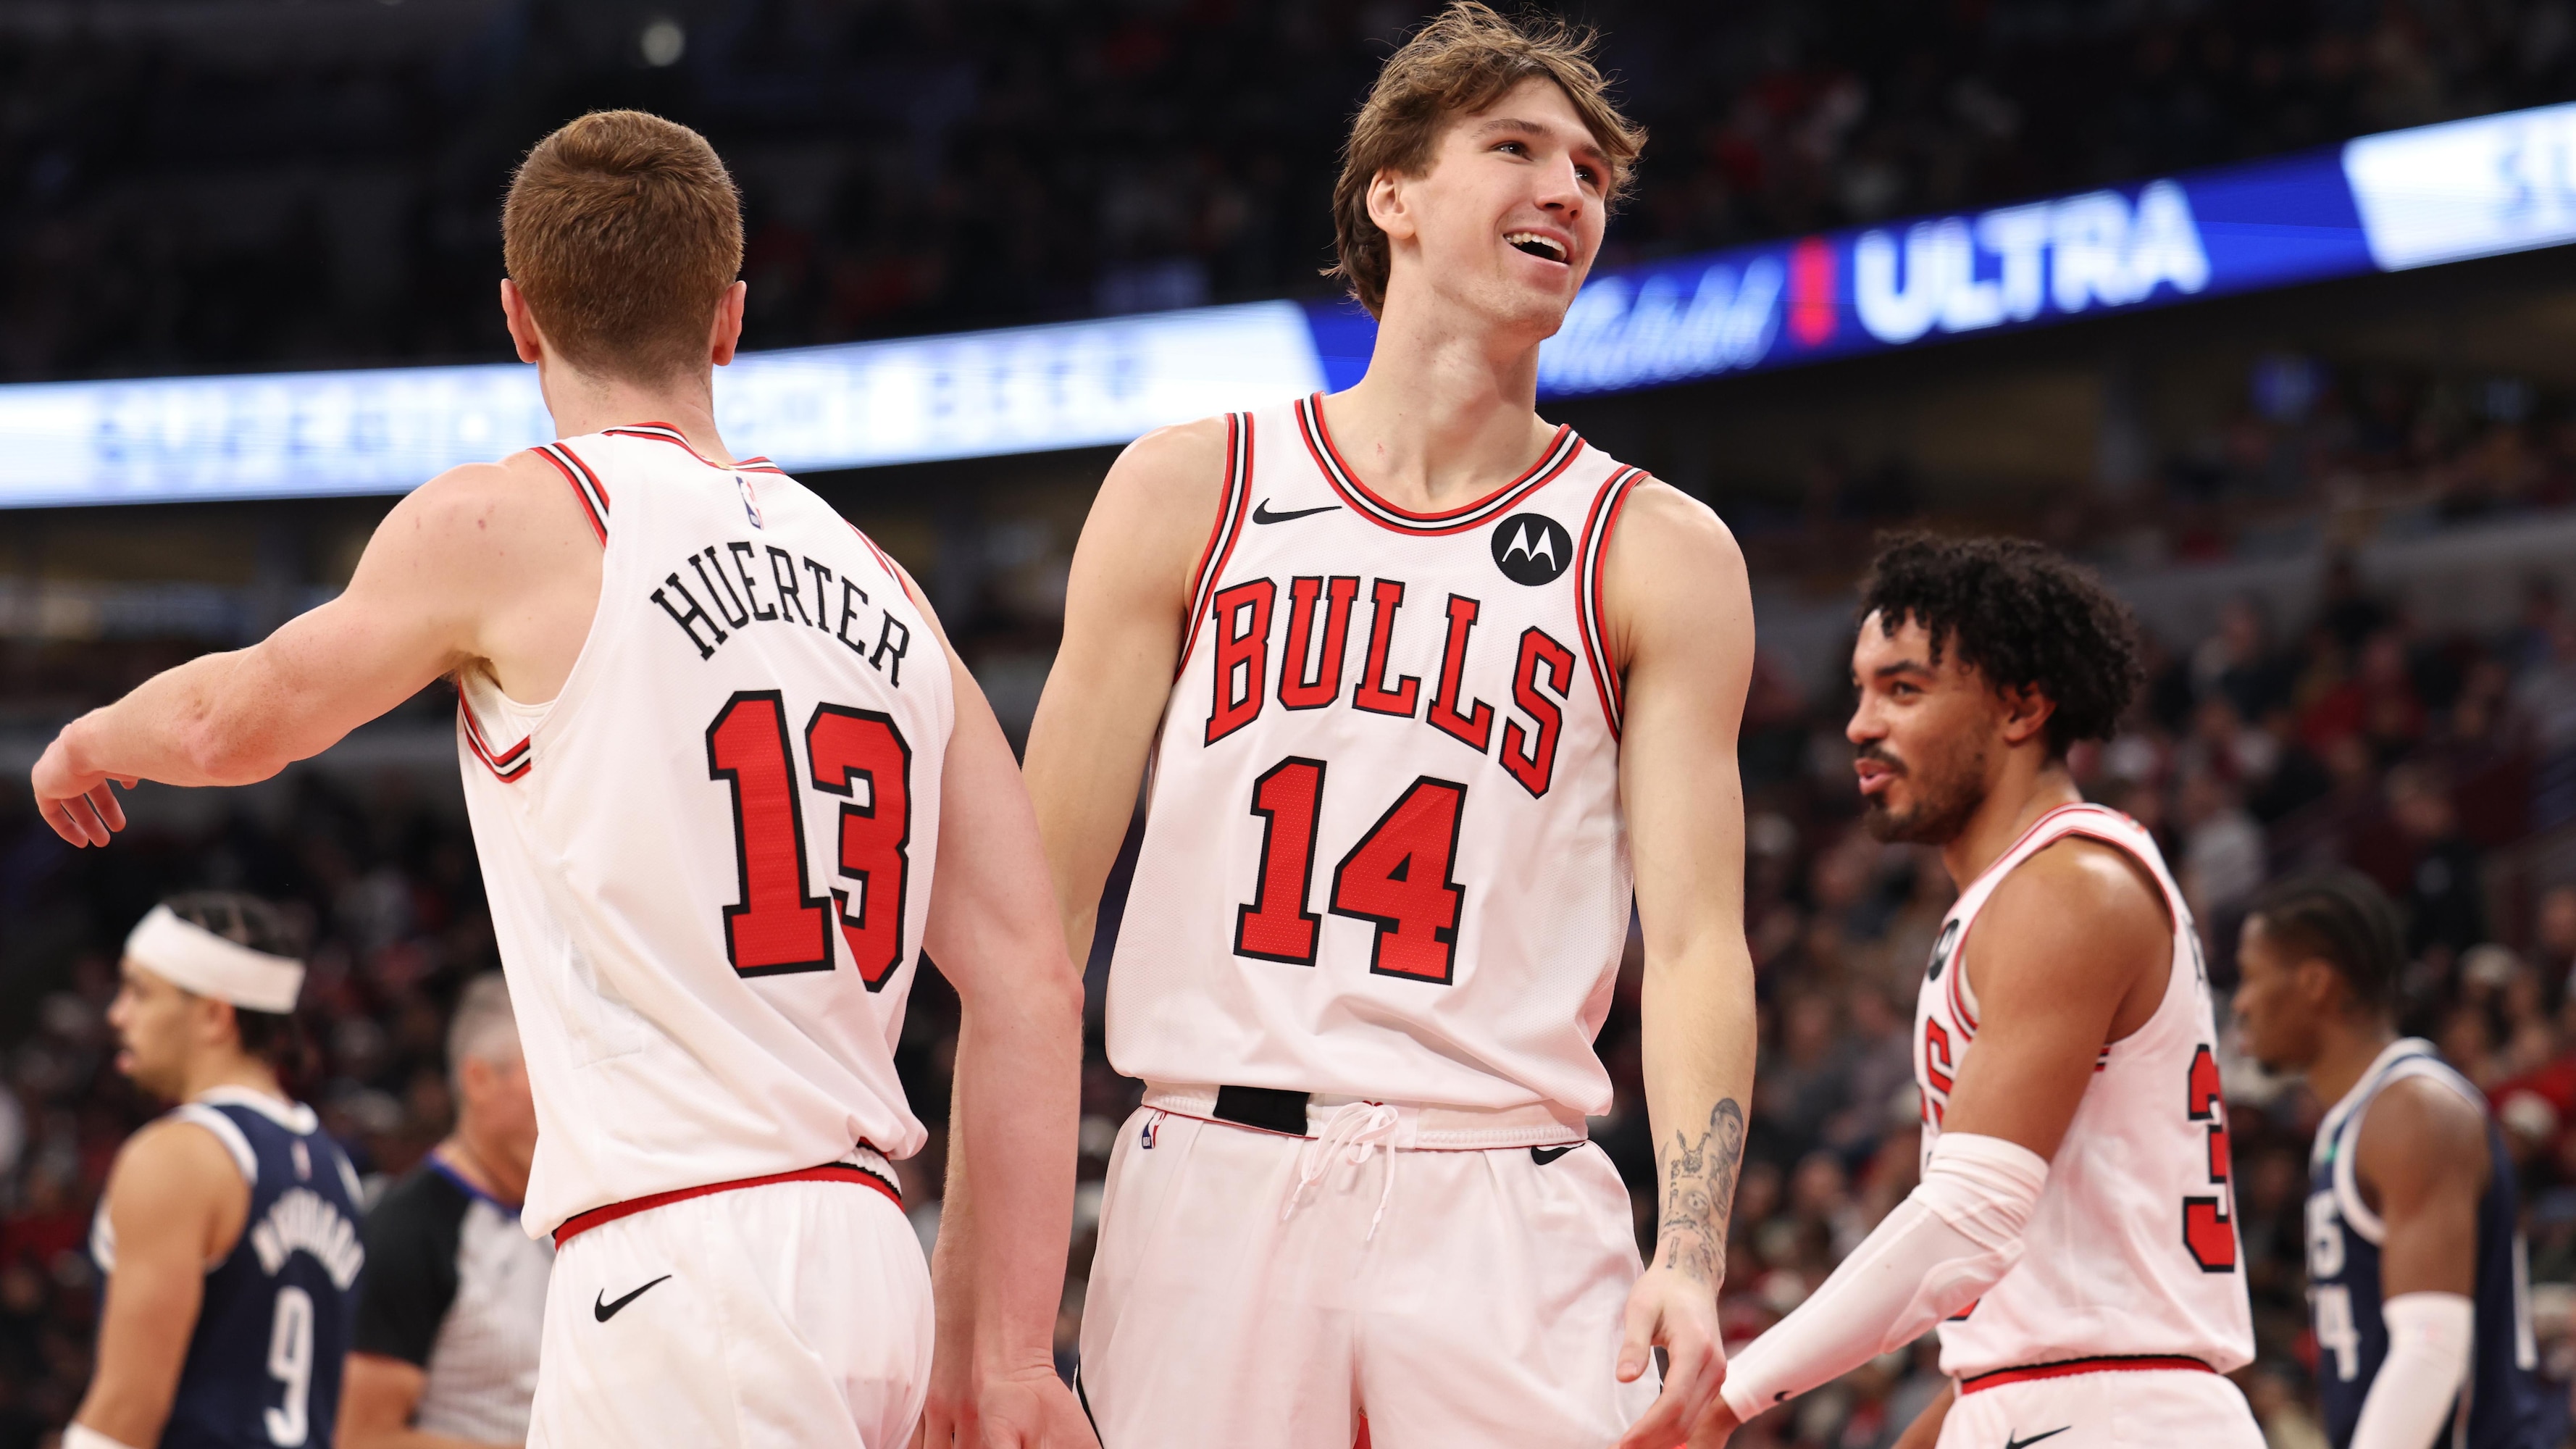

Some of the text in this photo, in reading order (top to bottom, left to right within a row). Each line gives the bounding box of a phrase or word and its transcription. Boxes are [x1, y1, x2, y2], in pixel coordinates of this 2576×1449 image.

[1855, 179, 2210, 344] ULTRA
[650, 541, 910, 661] HUERTER
[1204, 576, 1576, 799] BULLS
[706, 689, 911, 993] 13
[1233, 756, 1468, 985] 14
[262, 1285, 314, 1448] 9
